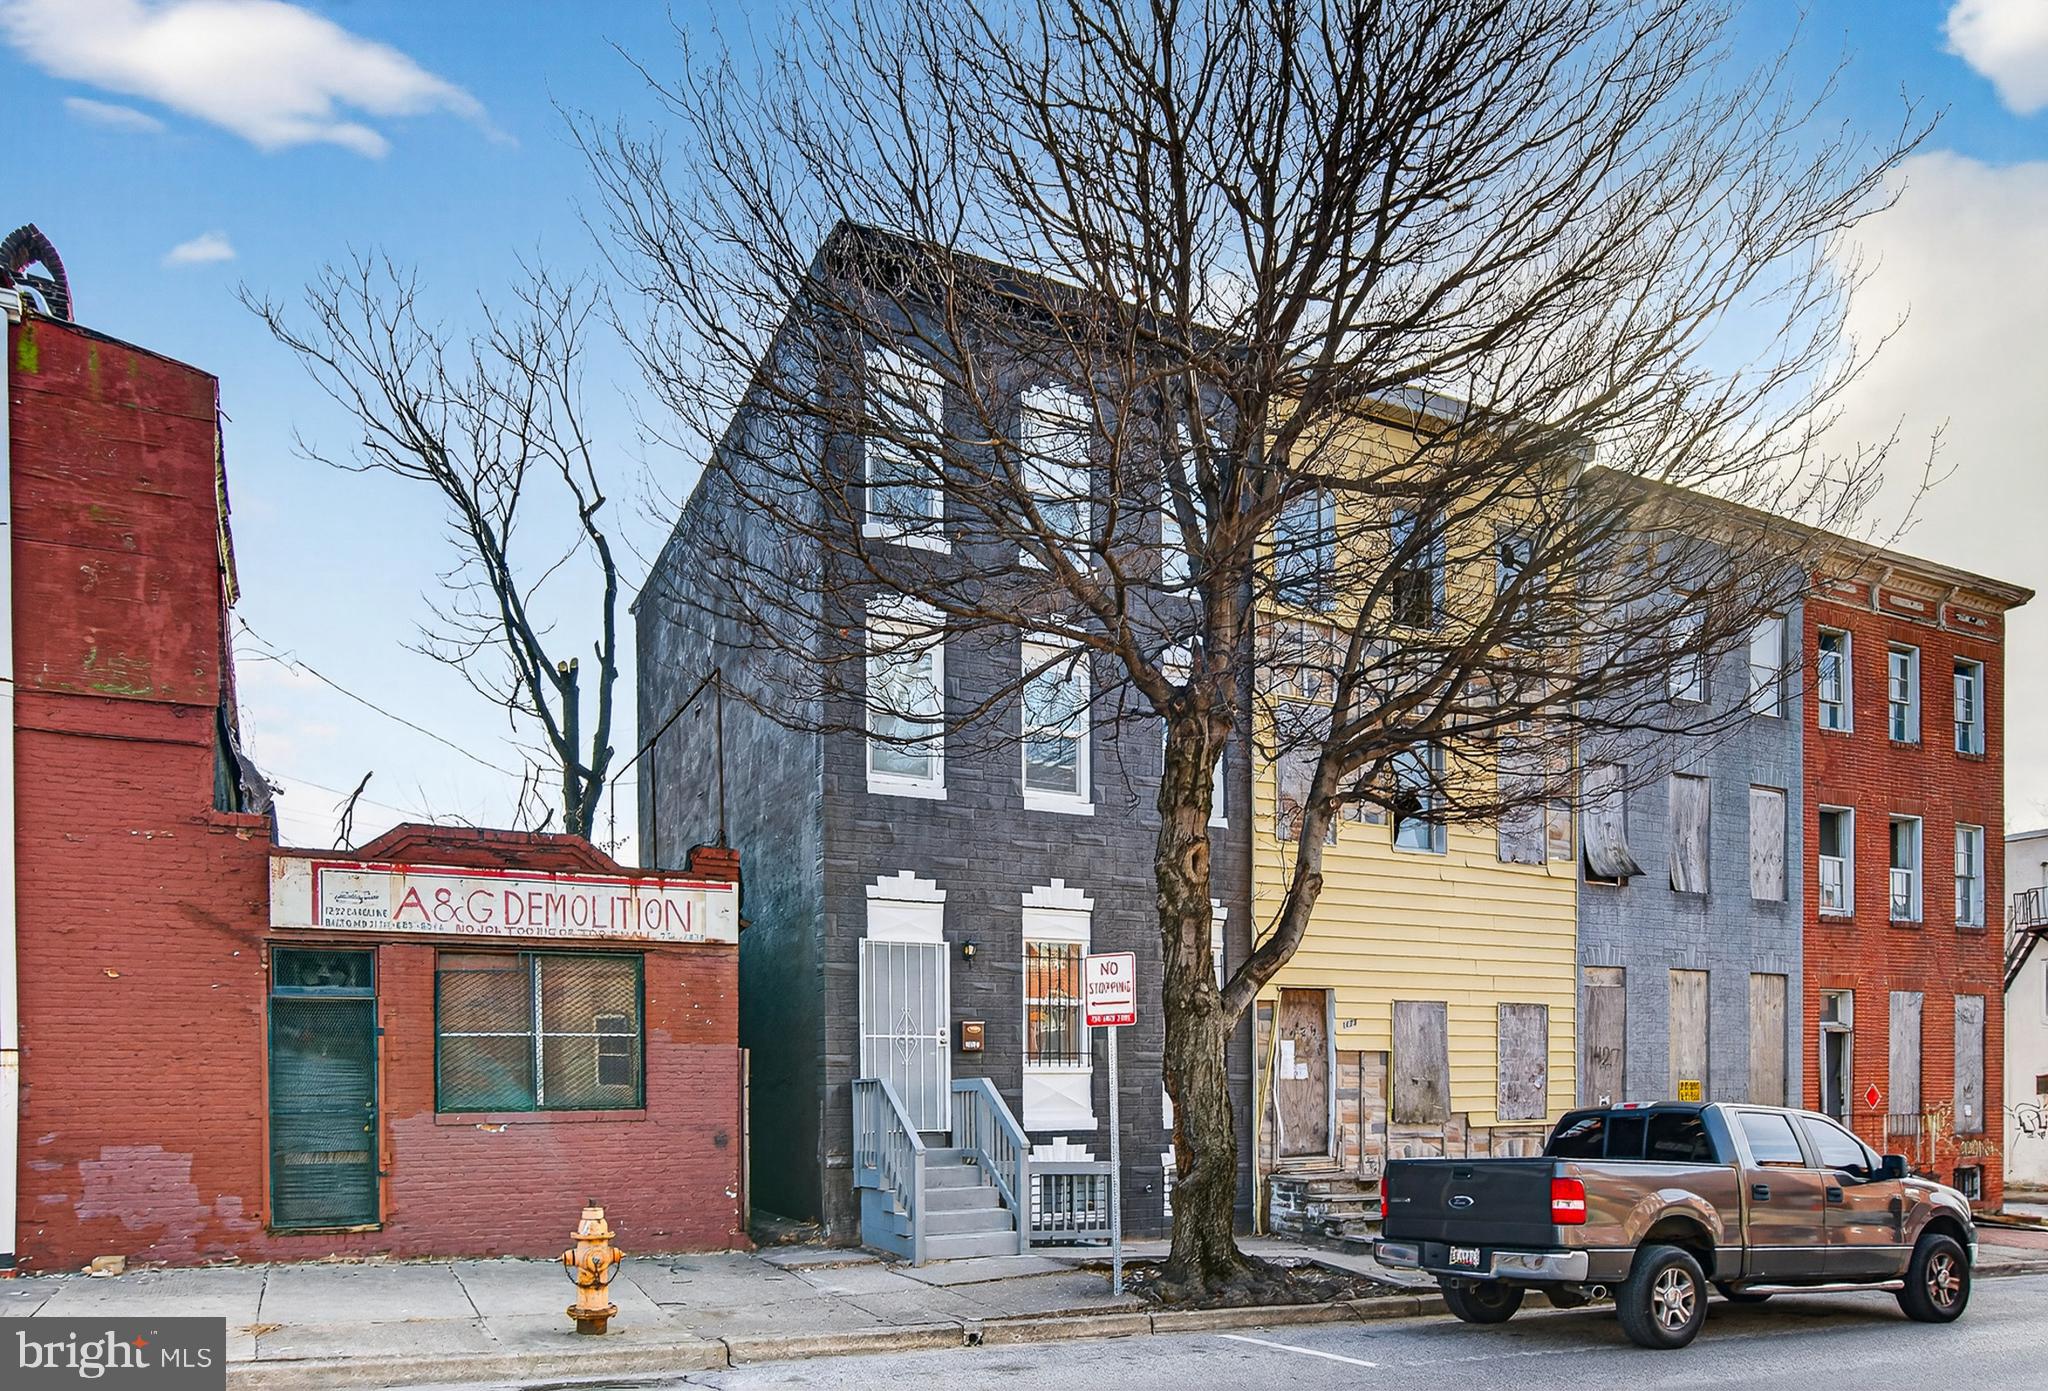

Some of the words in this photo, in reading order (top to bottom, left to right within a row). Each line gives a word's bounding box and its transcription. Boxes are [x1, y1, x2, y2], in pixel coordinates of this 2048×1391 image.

[393, 886, 494, 923] A&G
[504, 890, 691, 932] DEMOLITION
[456, 924, 474, 934] NO
[504, 926, 534, 936] TOO
[1100, 961, 1118, 975] NO
[1089, 980, 1131, 994] STOPPING
